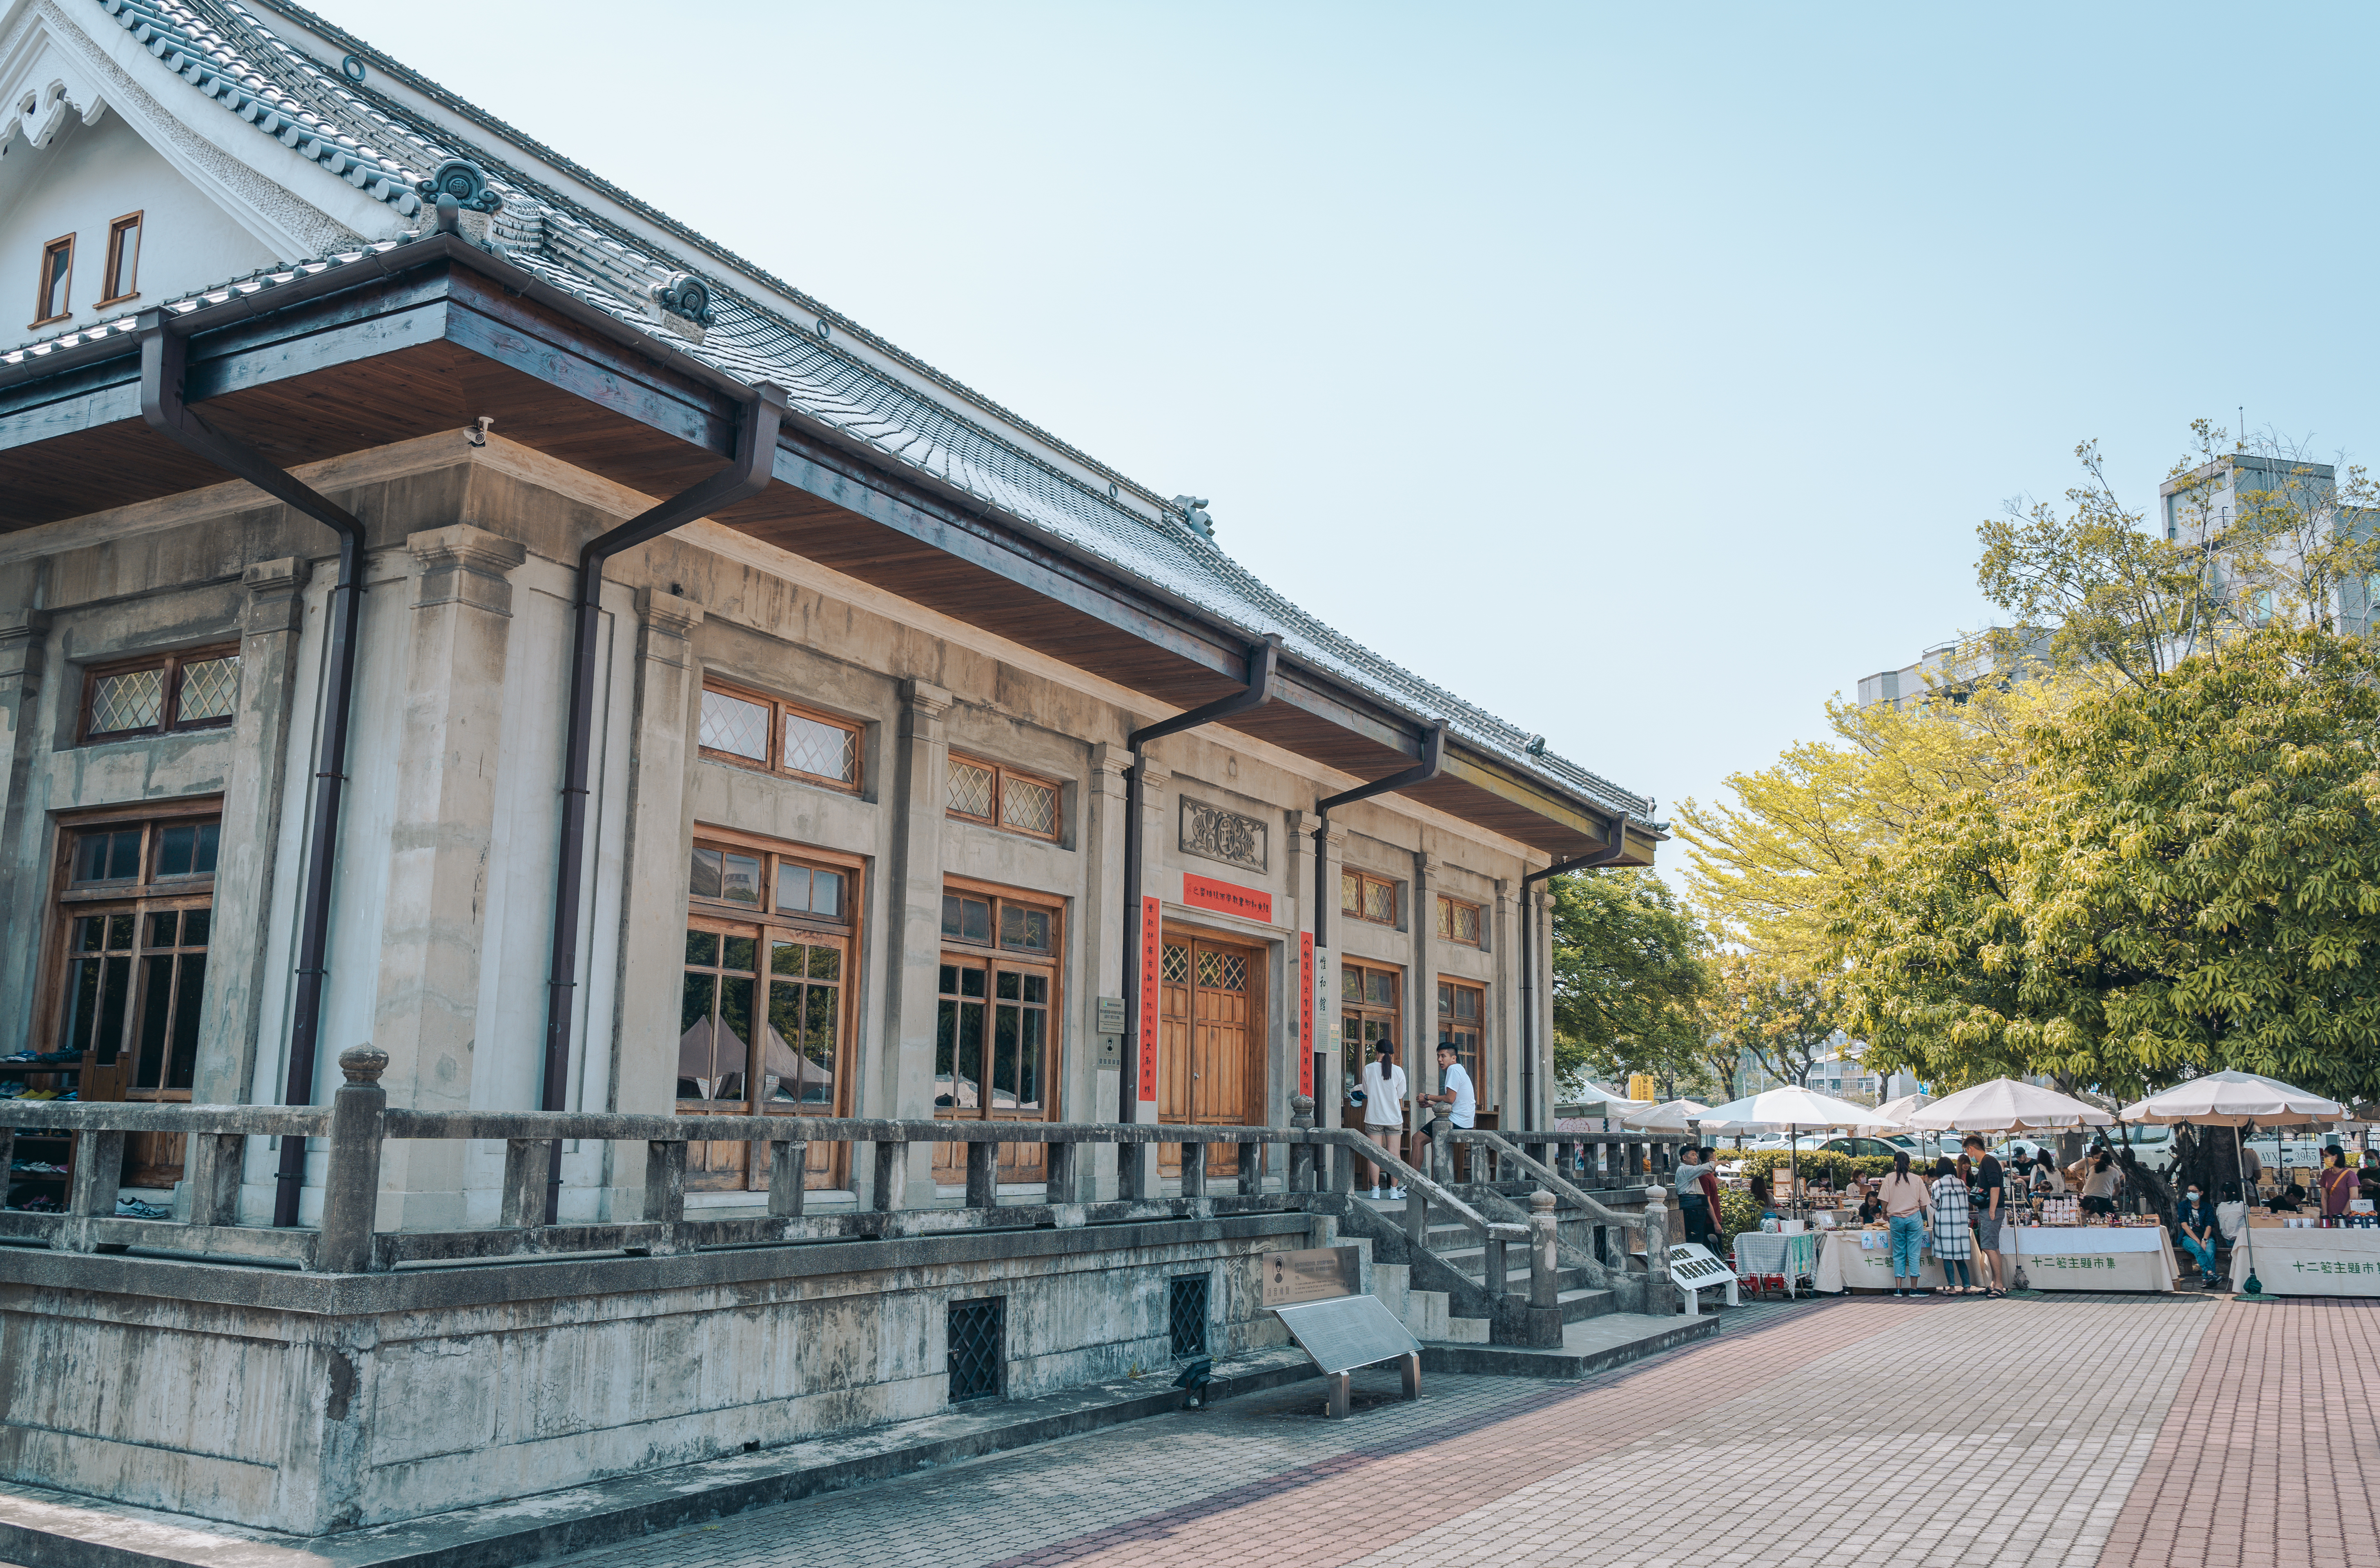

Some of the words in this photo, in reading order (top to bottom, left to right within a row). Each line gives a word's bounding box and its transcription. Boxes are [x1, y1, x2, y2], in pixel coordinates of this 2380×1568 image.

[2032, 1256, 2116, 1269] 十二籃主題市集
